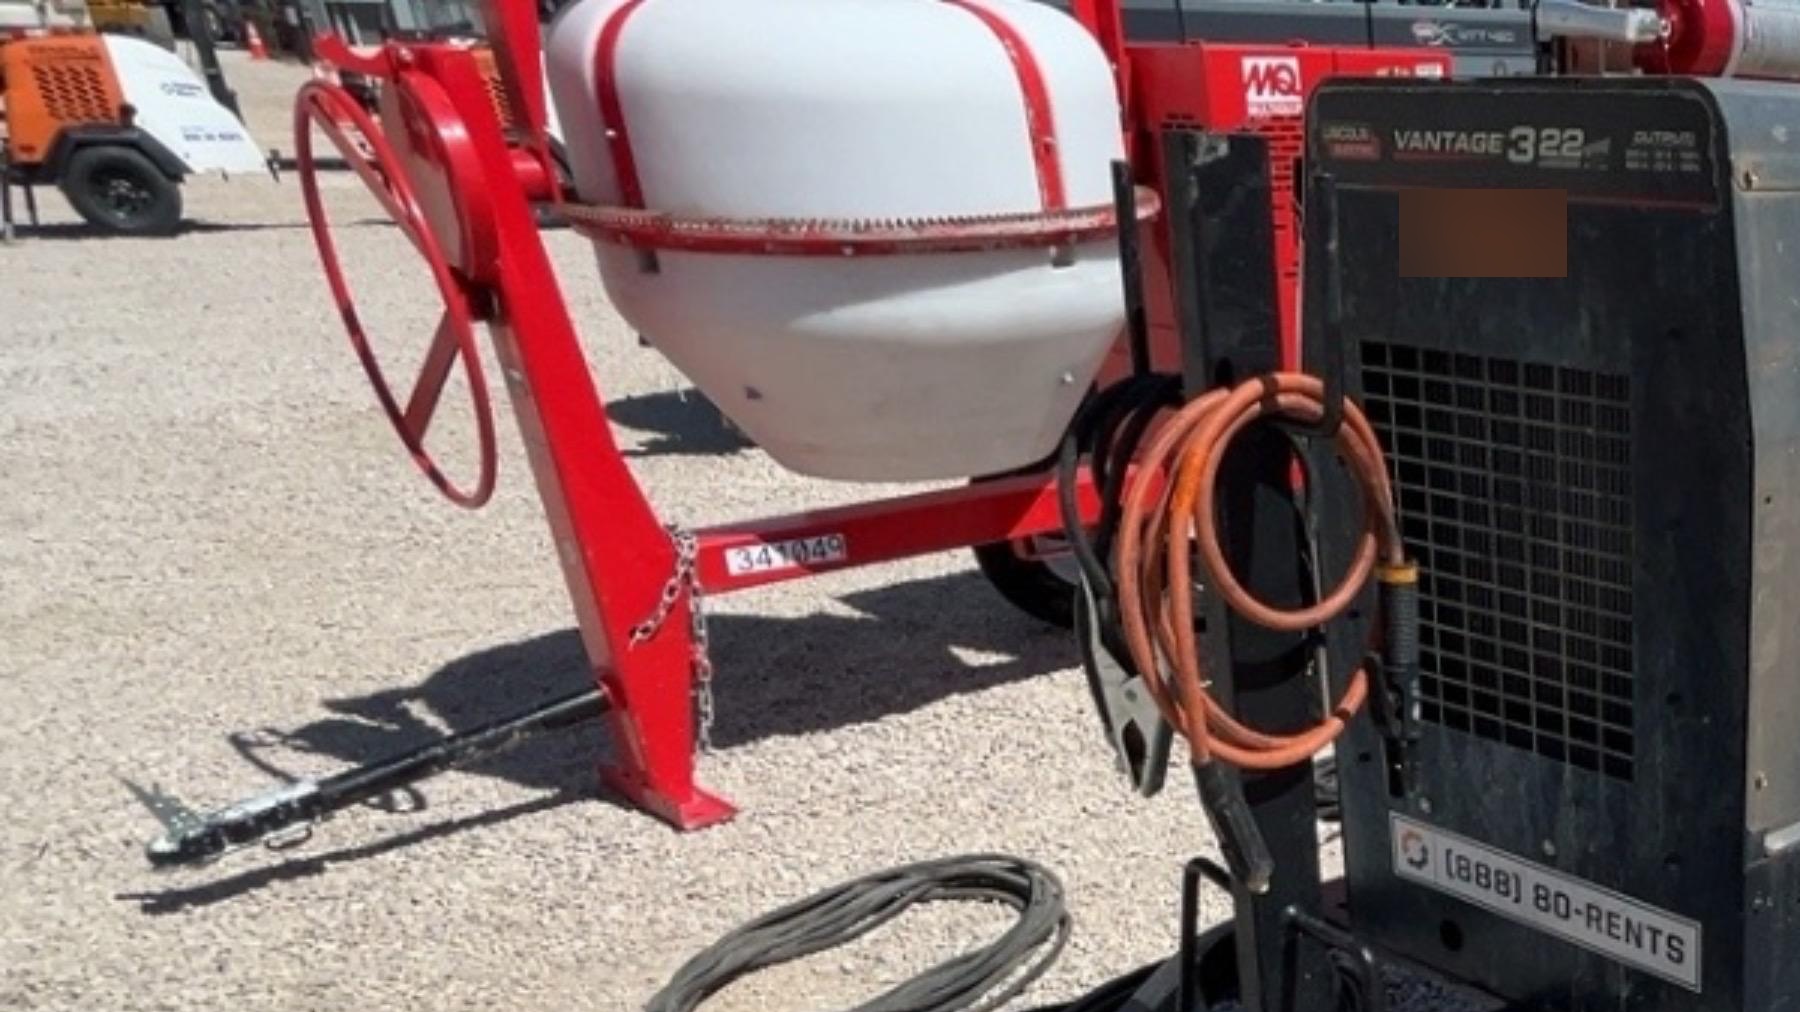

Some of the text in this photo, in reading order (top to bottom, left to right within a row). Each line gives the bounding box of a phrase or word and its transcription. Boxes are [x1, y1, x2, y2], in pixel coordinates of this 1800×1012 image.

[1246, 62, 1303, 96] MQ
[1394, 128, 1506, 153] VANTAGE
[1507, 125, 1585, 163] 322
[1532, 882, 1686, 965] 80-RENTS
